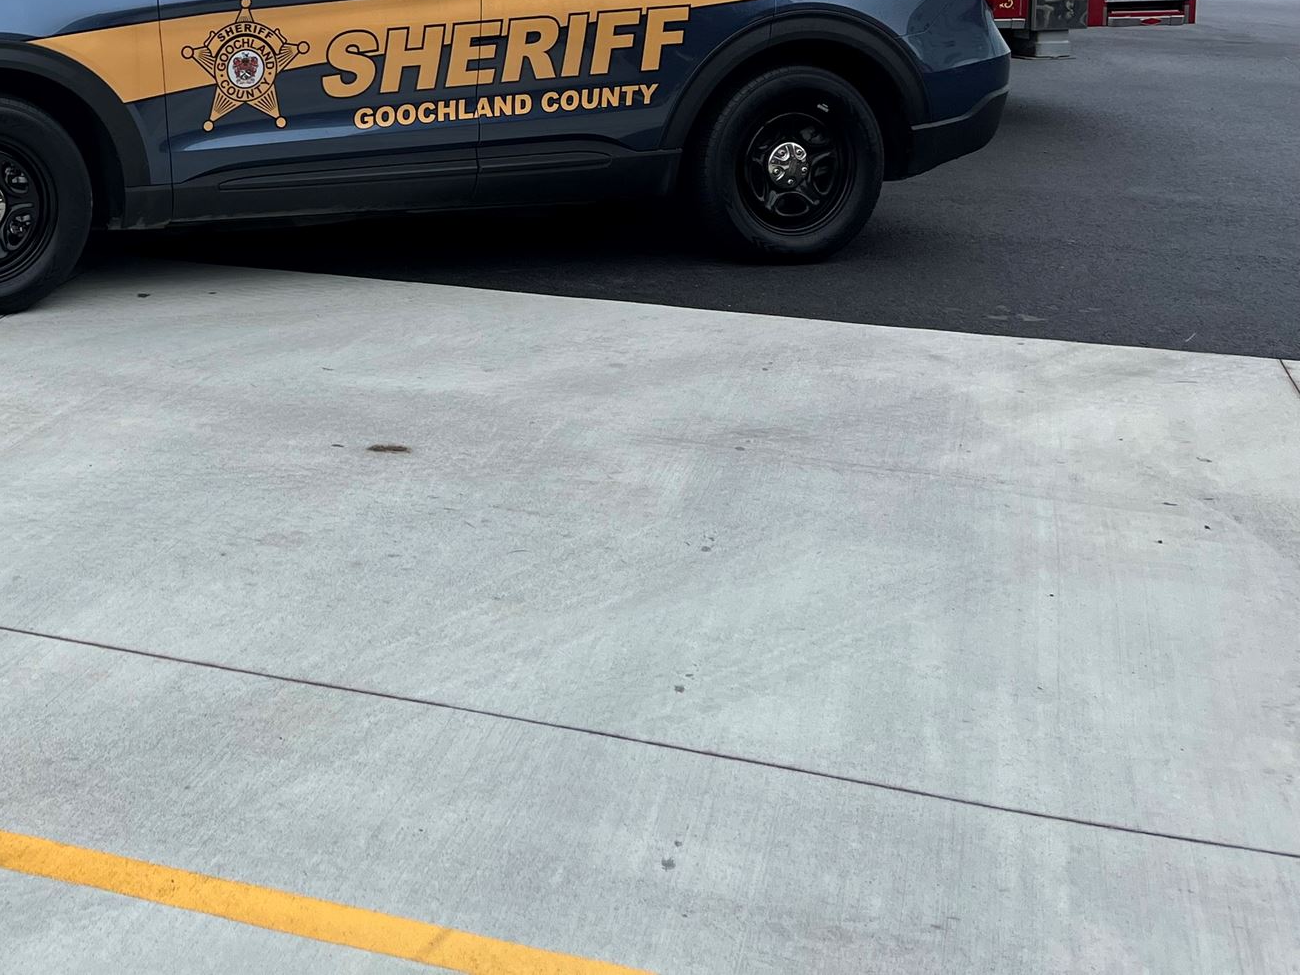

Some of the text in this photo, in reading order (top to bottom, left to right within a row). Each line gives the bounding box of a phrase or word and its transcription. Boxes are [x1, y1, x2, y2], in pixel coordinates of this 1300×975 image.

[216, 23, 274, 43] SHERIFF
[216, 38, 275, 73] GOOCHLAND
[321, 4, 692, 99] SHERIFF
[220, 77, 270, 100] COUNTY
[353, 83, 659, 130] GOOCHLAND COUNTY
